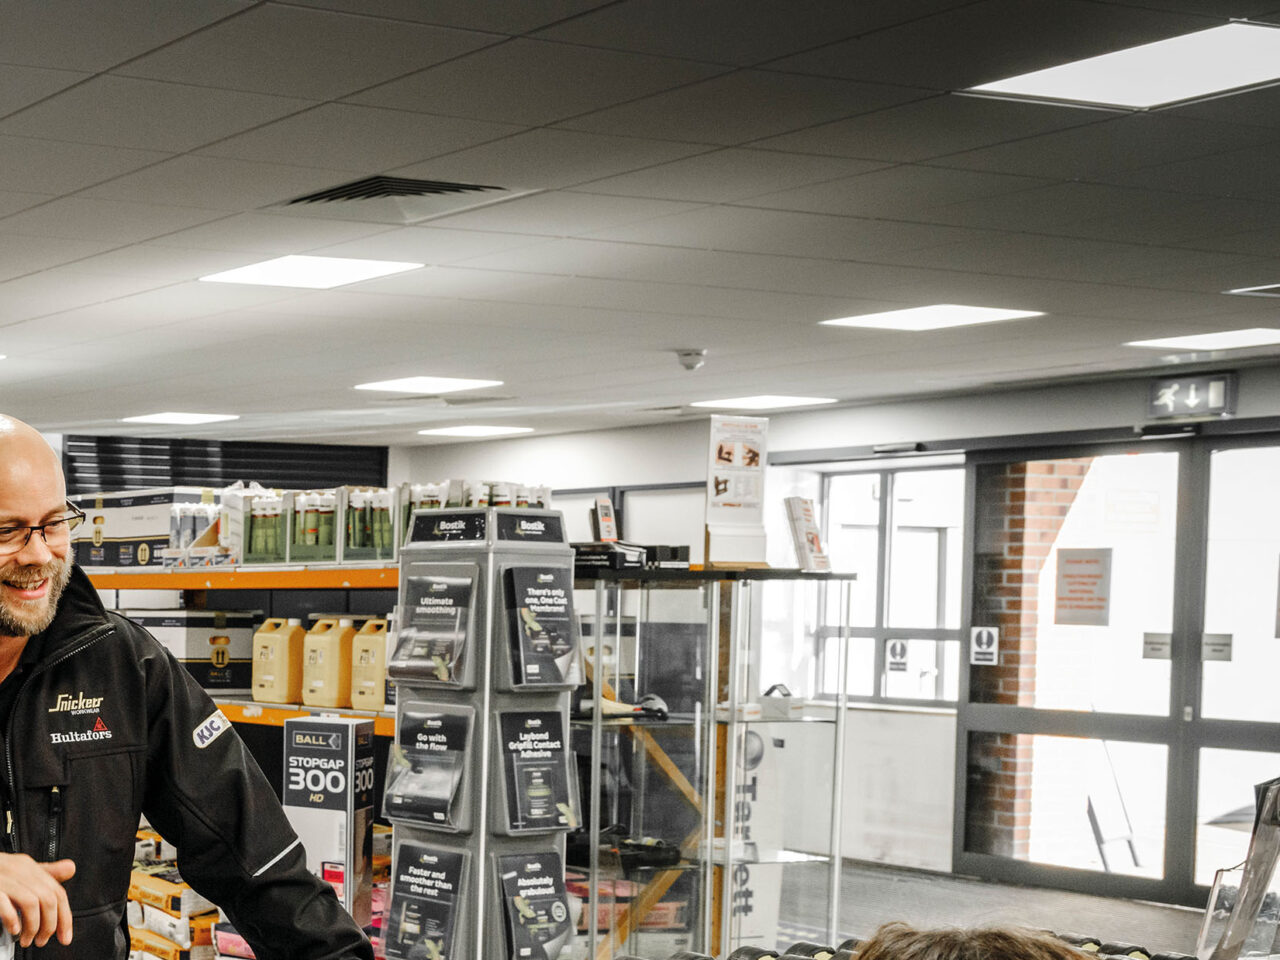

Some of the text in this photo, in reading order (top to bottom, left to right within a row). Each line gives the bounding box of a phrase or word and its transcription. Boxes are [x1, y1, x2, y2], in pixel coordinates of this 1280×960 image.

[440, 521, 465, 530] Bostik
[521, 521, 545, 531] Bostik
[420, 597, 454, 606] Ultimate
[416, 607, 456, 616] smoothing
[48, 692, 103, 712] Snickers
[71, 708, 100, 716] WORKWEAR
[50, 730, 113, 744] Hultafors
[196, 720, 221, 745] KJC
[417, 733, 447, 742] Go with
[296, 734, 327, 746] BALL
[534, 741, 561, 749] Contact
[288, 756, 345, 770] STOPGAP
[288, 768, 346, 793] 300
[356, 769, 374, 793] 300
[309, 794, 325, 803] HD
[408, 866, 446, 880] Faster and
[400, 875, 453, 890] smoother than
